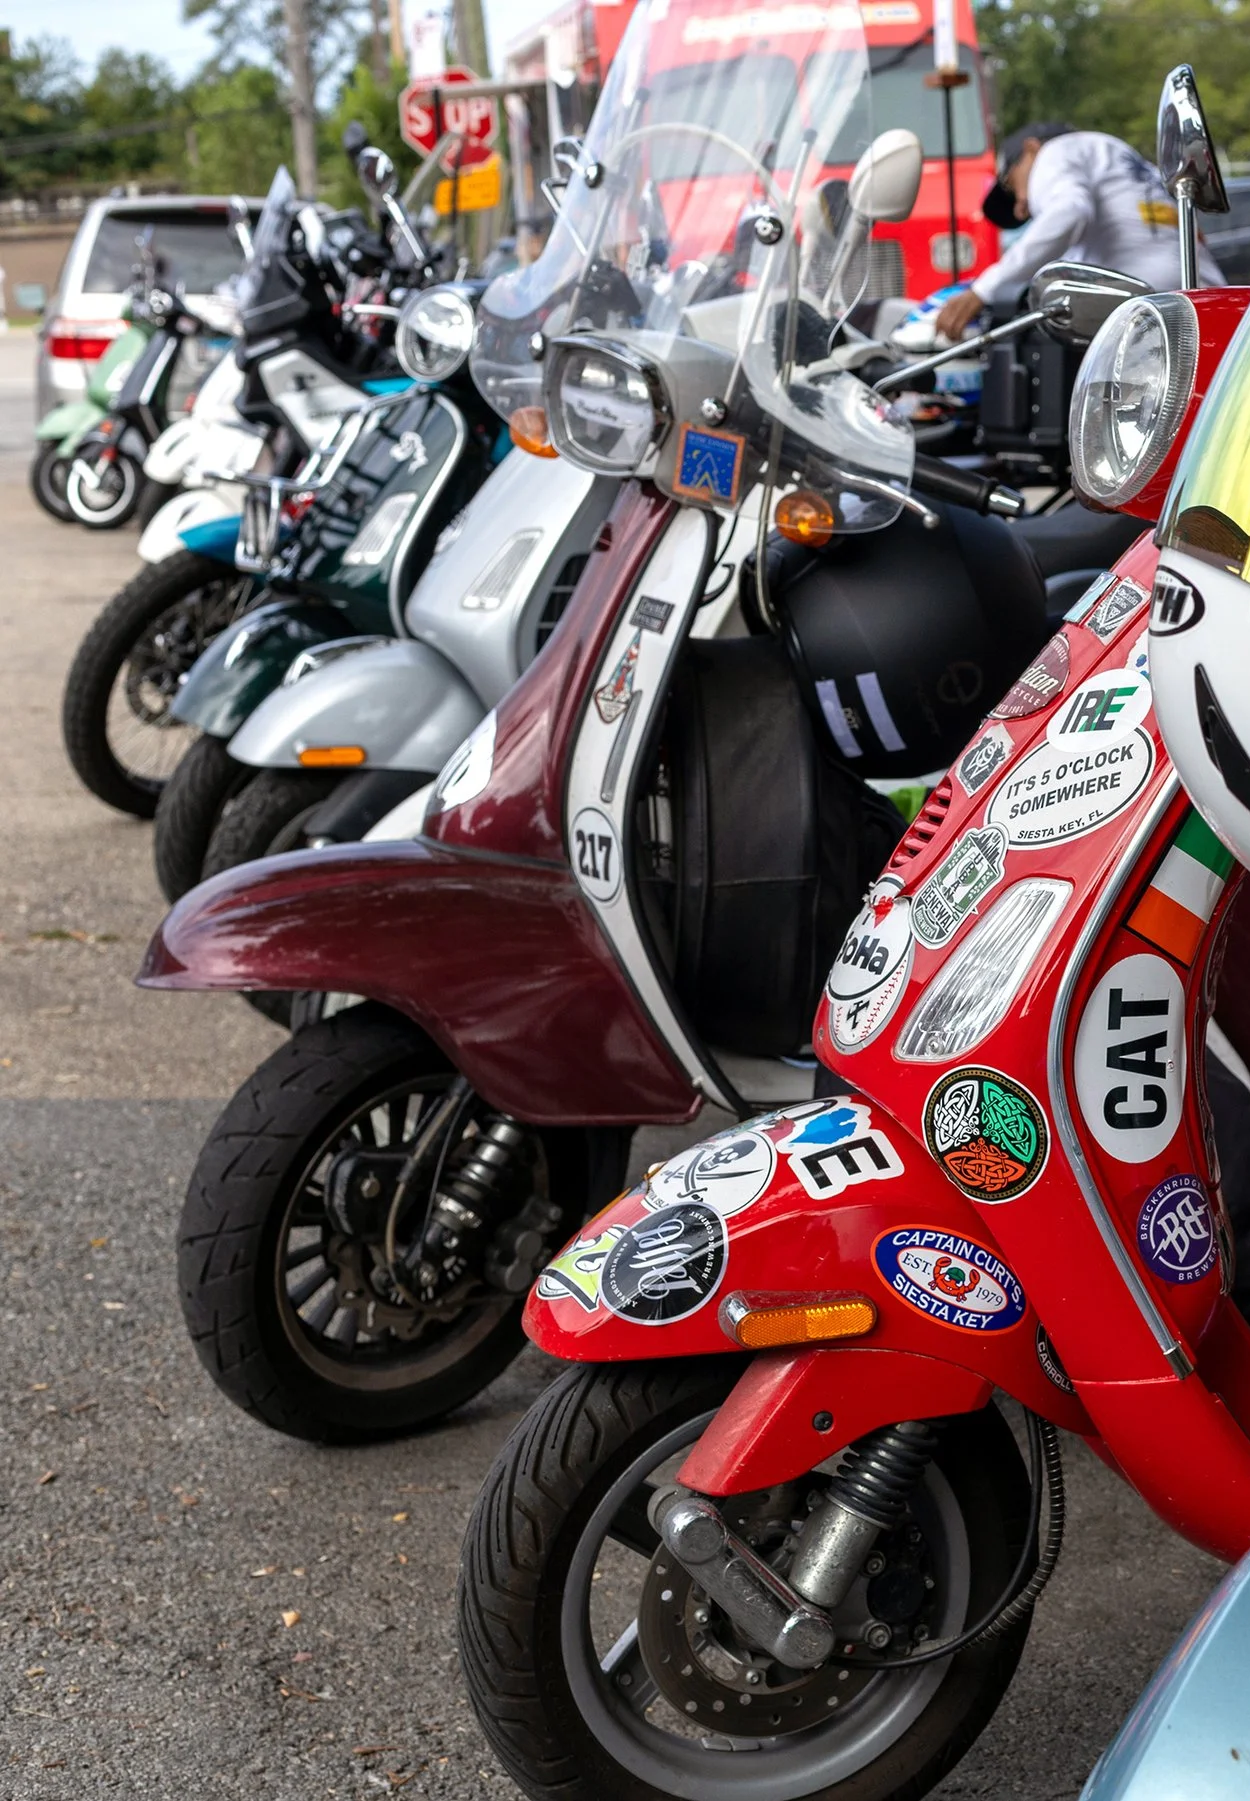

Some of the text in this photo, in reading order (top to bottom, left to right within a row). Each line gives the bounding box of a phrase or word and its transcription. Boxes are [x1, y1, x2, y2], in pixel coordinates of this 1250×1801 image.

[408, 98, 493, 137] SOP
[1059, 685, 1140, 735] IRE
[1006, 743, 1135, 800] IT'S 5 O'CLOCK
[1008, 771, 1122, 820] SOMEWHERE
[1017, 808, 1104, 840] SIESTA KEY, FL
[575, 829, 613, 883] 217
[943, 852, 984, 901] URBAN
[914, 910, 937, 938] BREWERY
[921, 884, 955, 934] RENEWAL
[1103, 987, 1170, 1131] CAT
[608, 1241, 629, 1280] BREWING
[688, 1210, 716, 1280] BREWING COMPANY
[892, 1231, 976, 1260] CAPTAIN
[973, 1249, 1024, 1304] CURT'S
[892, 1273, 994, 1329] SIESTA KEY
[902, 1252, 1004, 1307] EST. 1979
[1037, 1341, 1071, 1391] CARROLL
